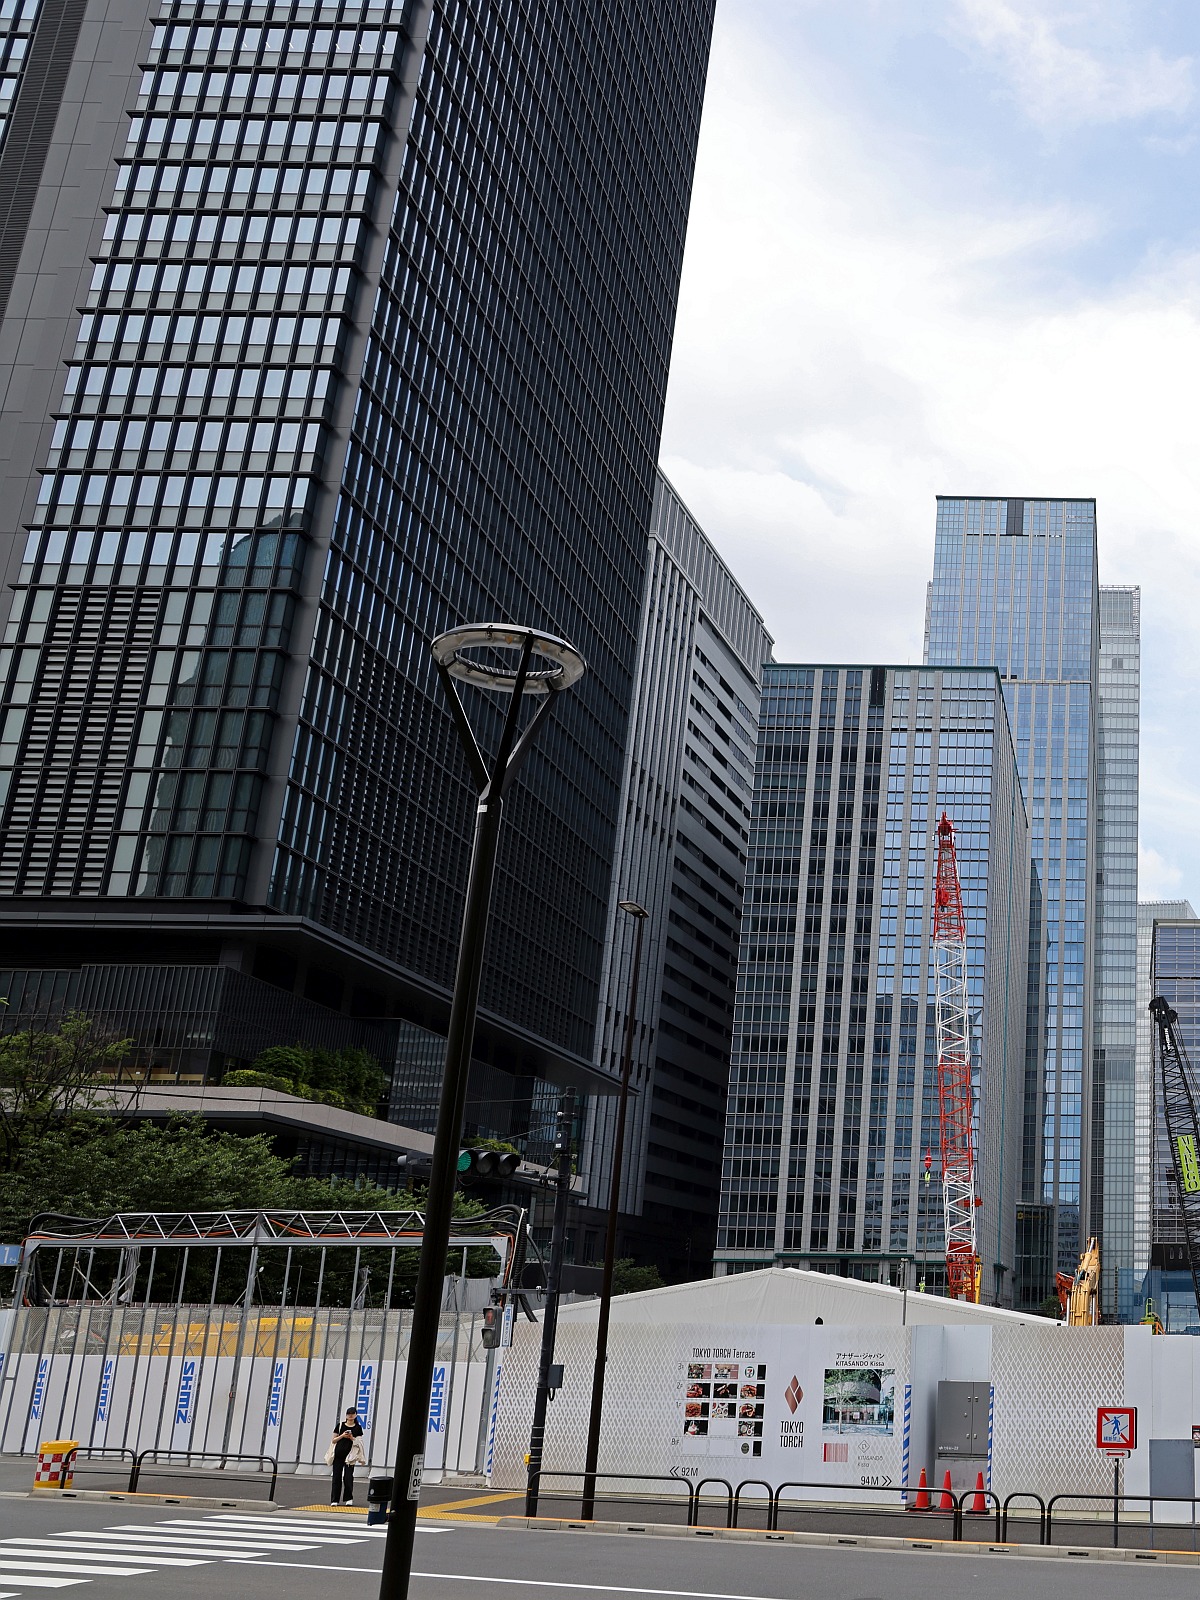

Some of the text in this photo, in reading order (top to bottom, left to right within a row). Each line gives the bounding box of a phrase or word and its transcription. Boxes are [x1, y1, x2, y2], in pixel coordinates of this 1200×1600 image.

[1181, 1135, 1199, 1190] MARUGO
[692, 1347, 756, 1359] TOKYO TORCH Terrace
[780, 1420, 804, 1434] TOKYO
[779, 1435, 804, 1448] TORCH
[681, 1467, 699, 1477] 92M
[860, 1475, 879, 1486] 94M
